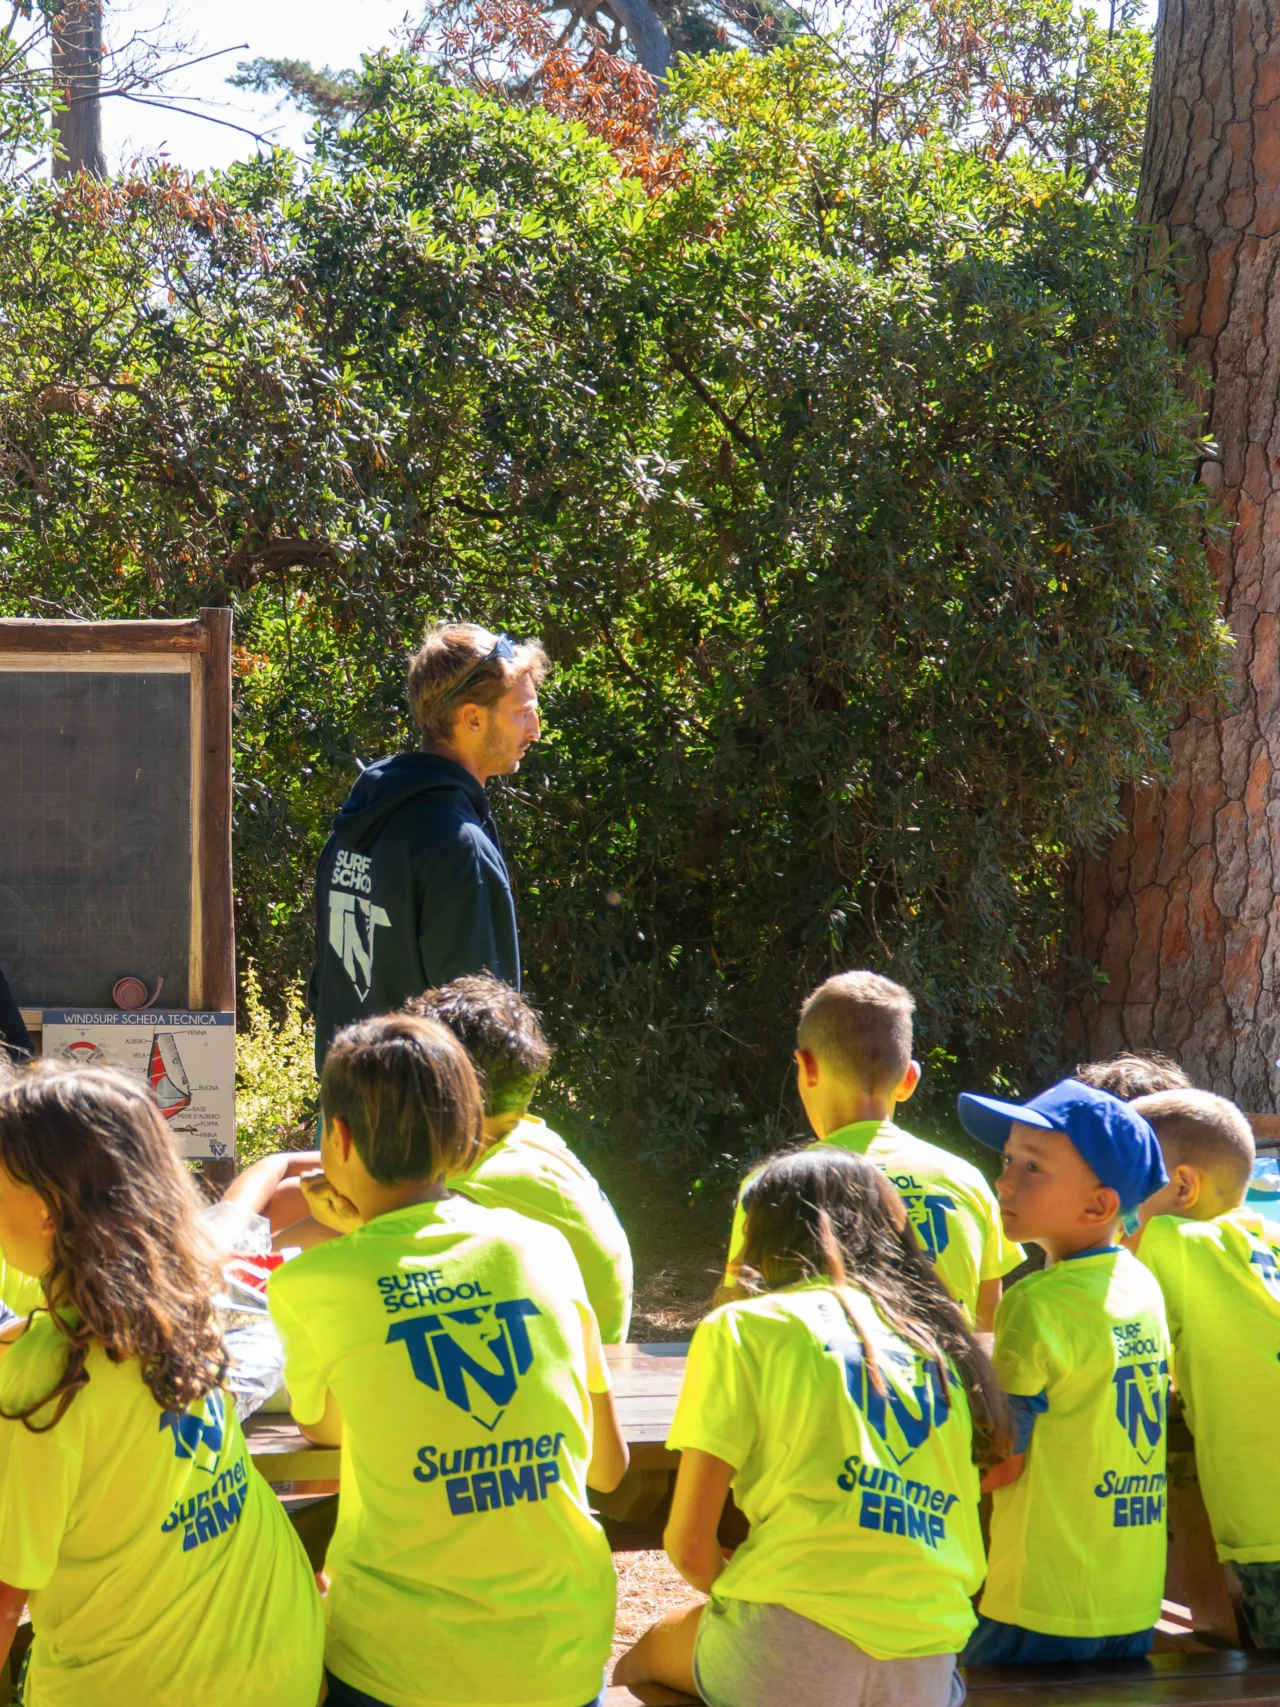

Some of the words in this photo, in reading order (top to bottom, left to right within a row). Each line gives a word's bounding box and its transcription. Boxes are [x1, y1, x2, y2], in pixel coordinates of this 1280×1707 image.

[335, 850, 372, 873] SURF
[63, 1013, 119, 1024] WINDSURF
[121, 1014, 166, 1025] SCHEDA
[168, 1014, 217, 1025] TECNICA
[377, 1269, 443, 1294] SURF
[384, 1281, 492, 1313] SCHOOL
[1113, 1323, 1141, 1341] SURF
[386, 1298, 542, 1413] TNT
[1118, 1338, 1158, 1359] SCHOOL
[413, 1432, 565, 1483] Summer
[445, 1460, 560, 1516] CAMP
[837, 1455, 960, 1516] Summer
[1094, 1469, 1166, 1498] Summ
[859, 1490, 946, 1549] CAMP
[1114, 1494, 1165, 1528] CAM
